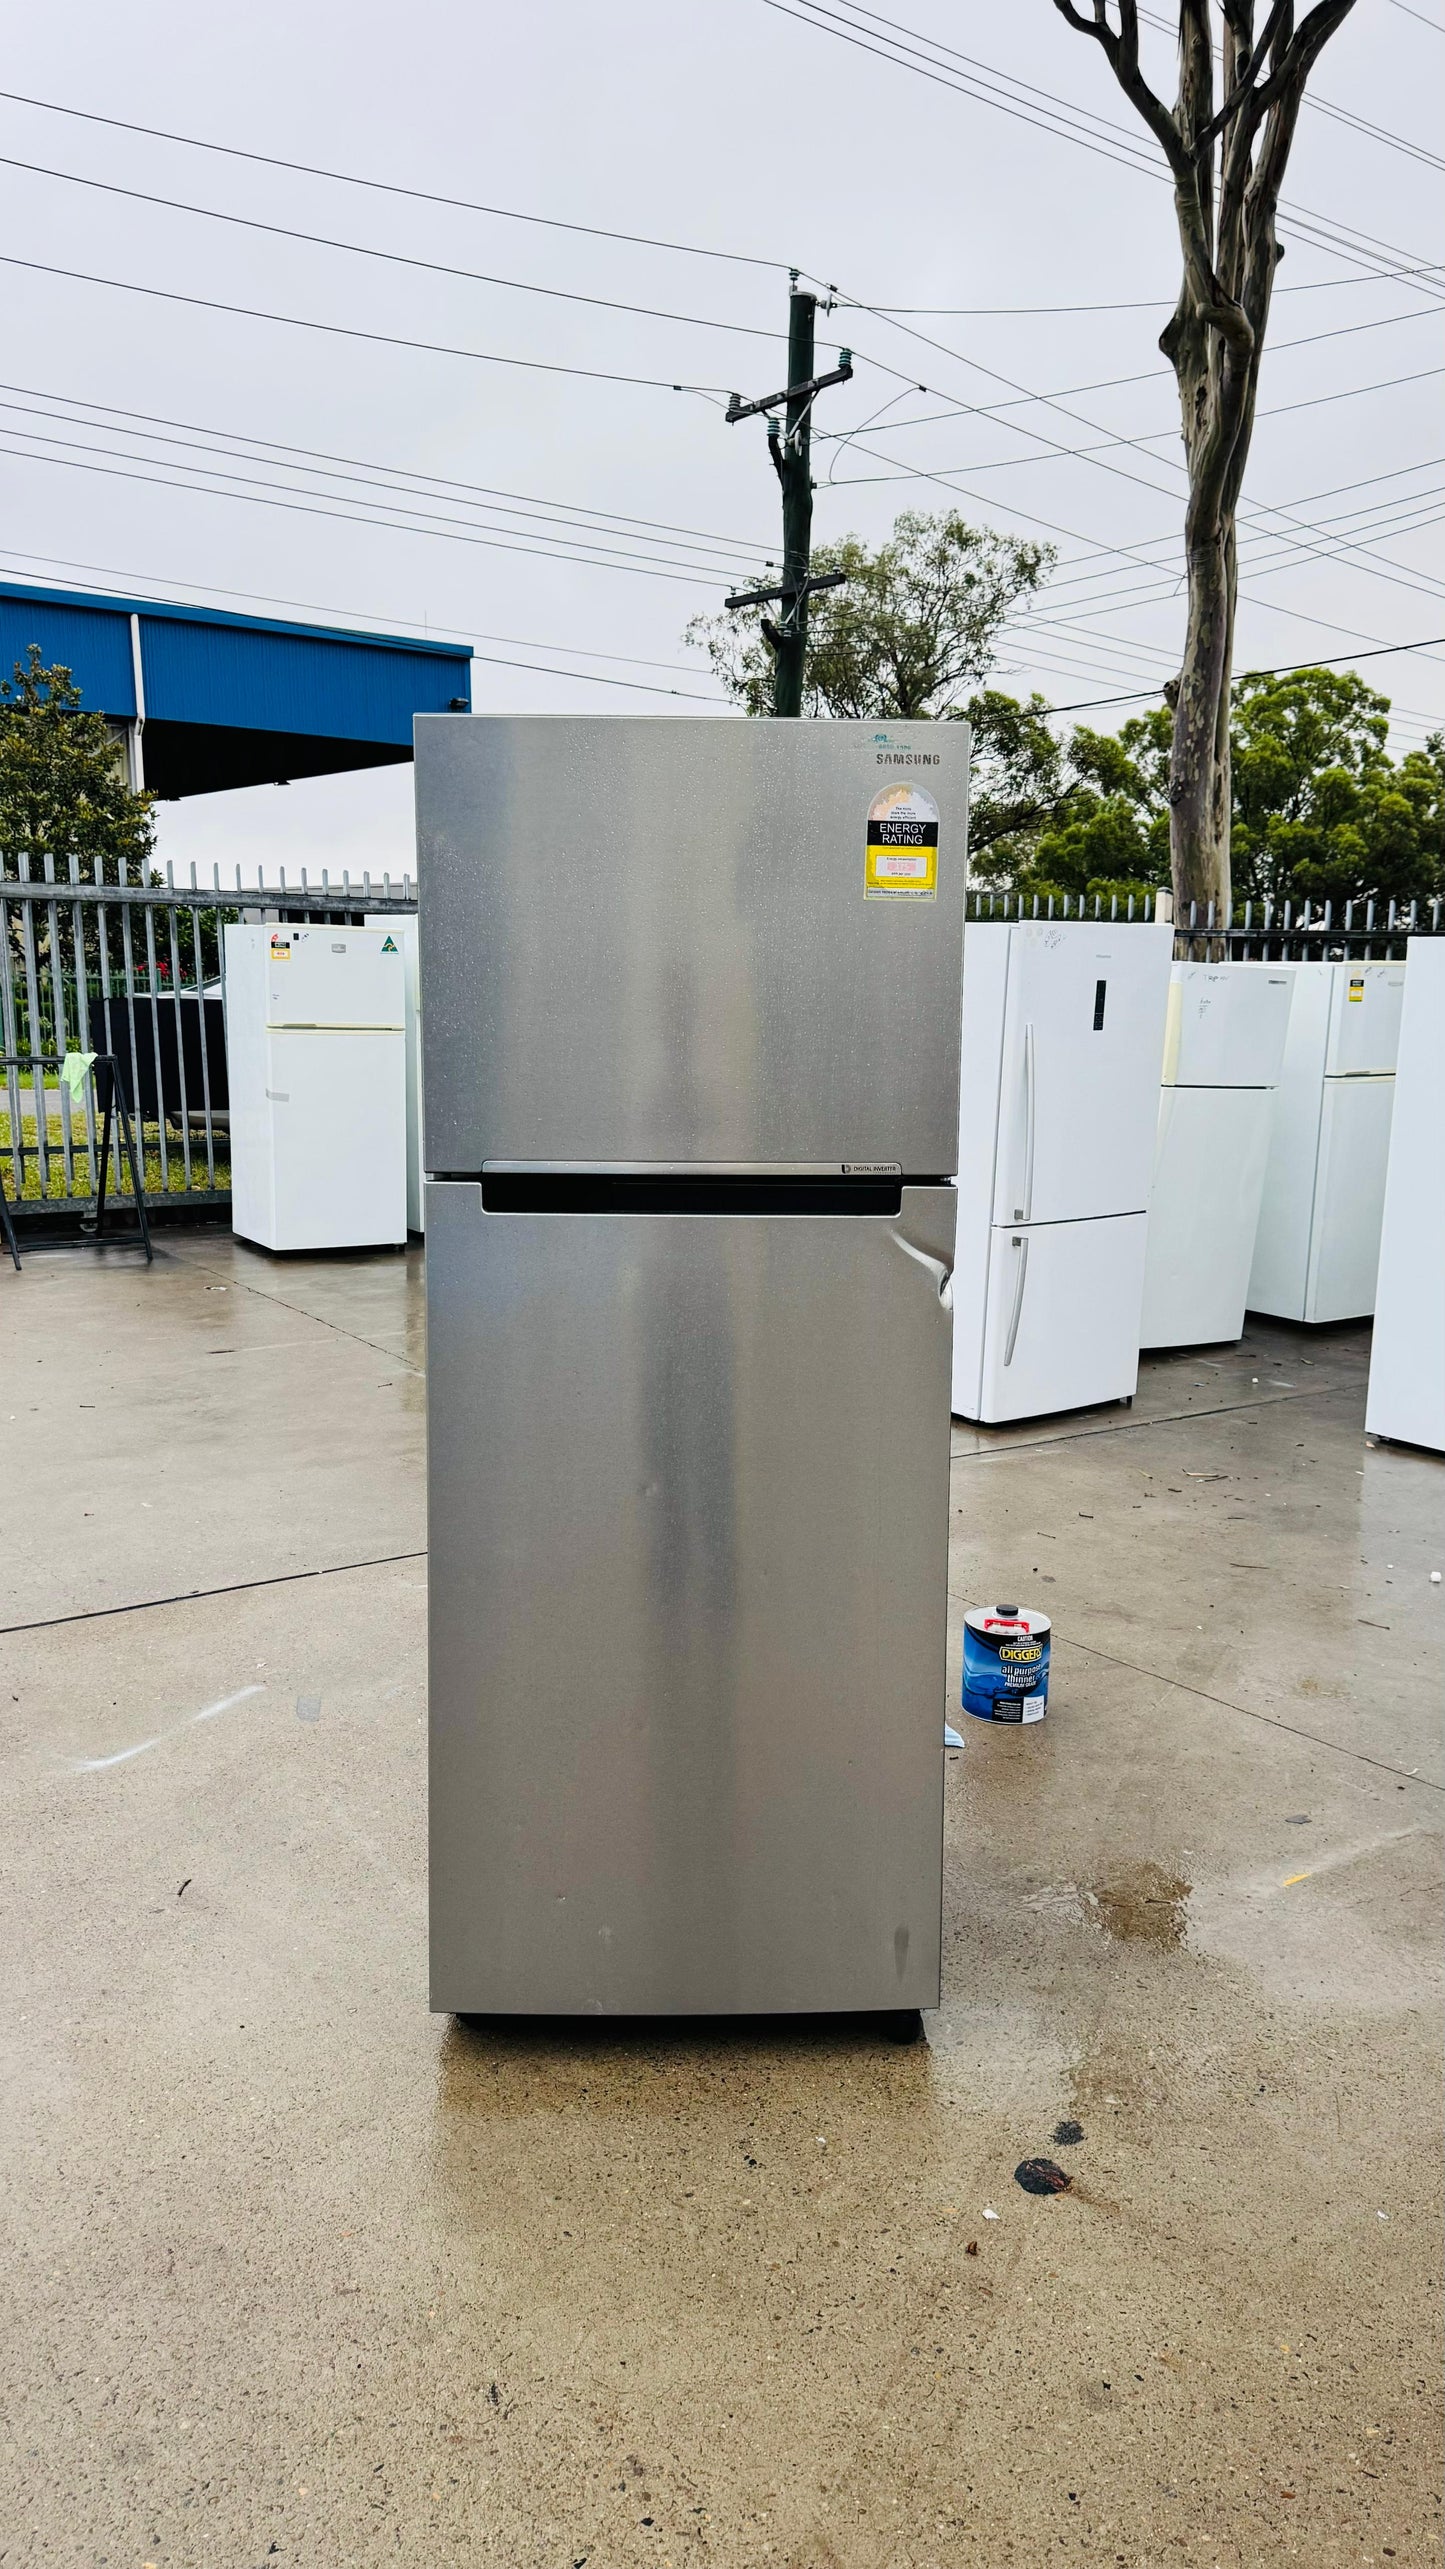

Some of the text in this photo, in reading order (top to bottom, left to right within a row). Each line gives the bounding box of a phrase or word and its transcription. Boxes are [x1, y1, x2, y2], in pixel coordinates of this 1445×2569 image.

[876, 753, 940, 765] SAMSUNG
[880, 823, 927, 834] ENERGY
[882, 833, 923, 845] RATING
[1002, 1665, 1013, 1674] all
[1007, 1674, 1036, 1683] thinner
